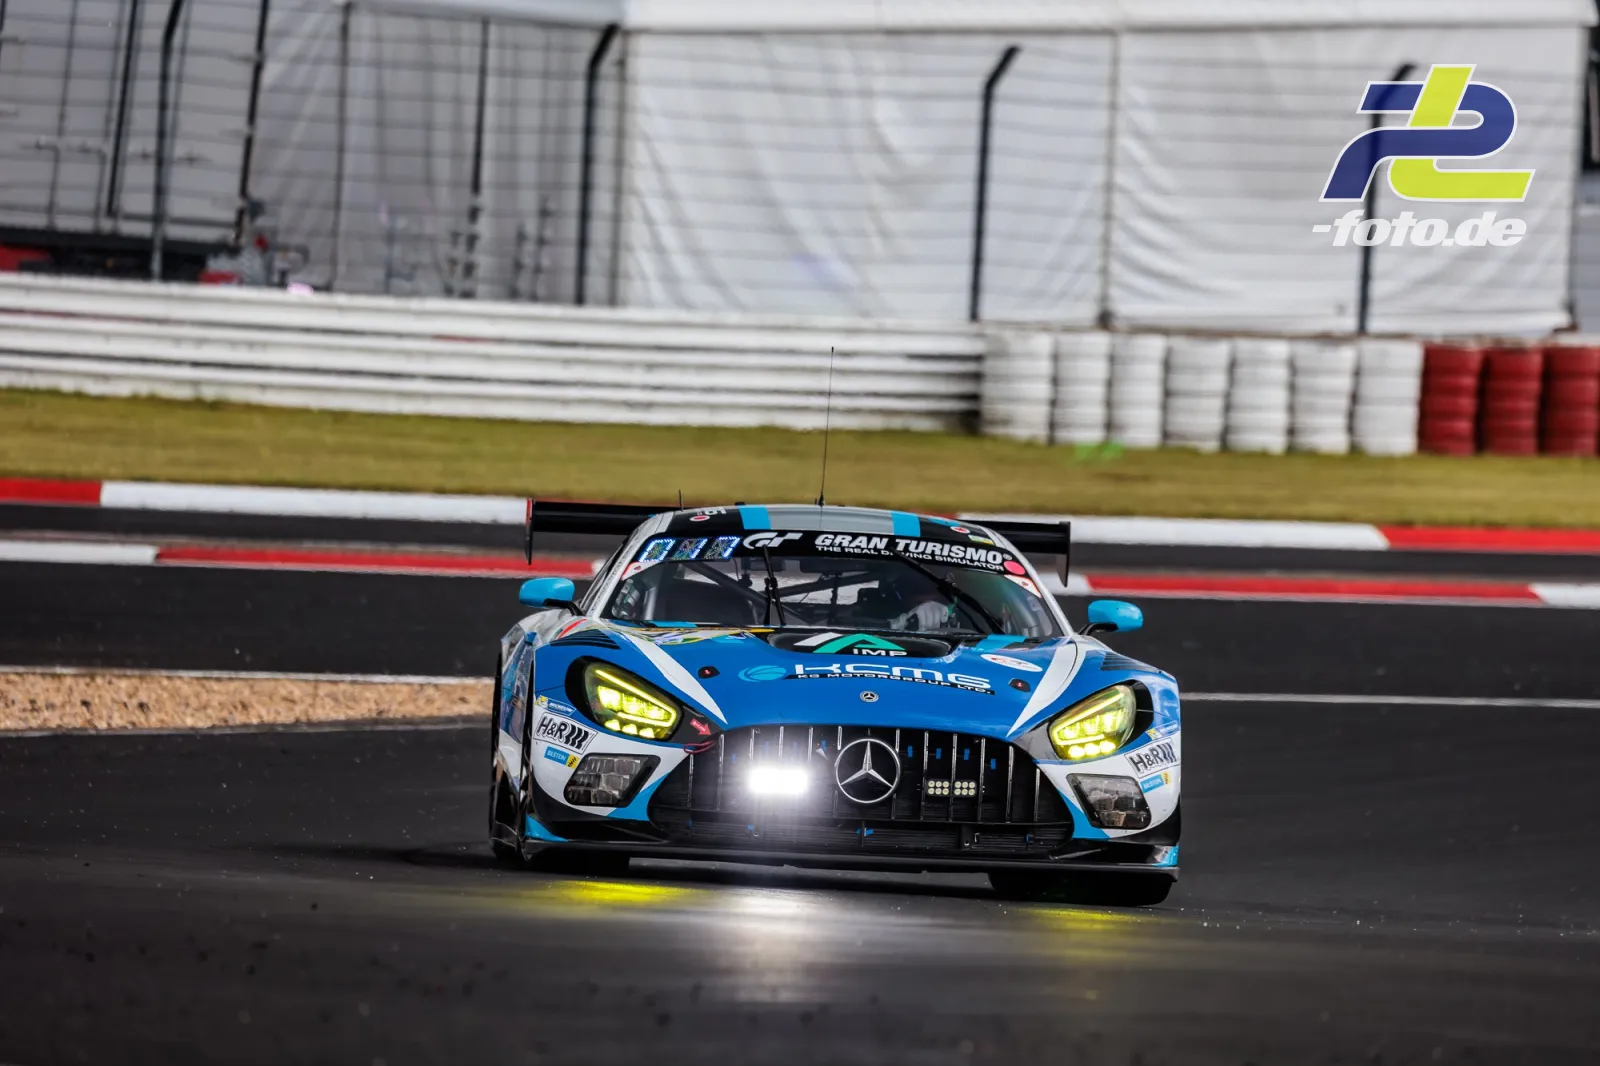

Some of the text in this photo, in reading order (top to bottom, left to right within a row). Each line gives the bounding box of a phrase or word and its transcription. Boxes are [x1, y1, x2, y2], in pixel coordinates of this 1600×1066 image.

[814, 534, 889, 549] GRAN
[815, 545, 842, 553] THE
[844, 547, 878, 555] REAL
[934, 553, 1005, 571] SIMULATOR
[852, 648, 907, 657] IMP
[794, 663, 992, 689] KCMG
[537, 716, 568, 740] H&R
[1129, 745, 1164, 772] H&R
